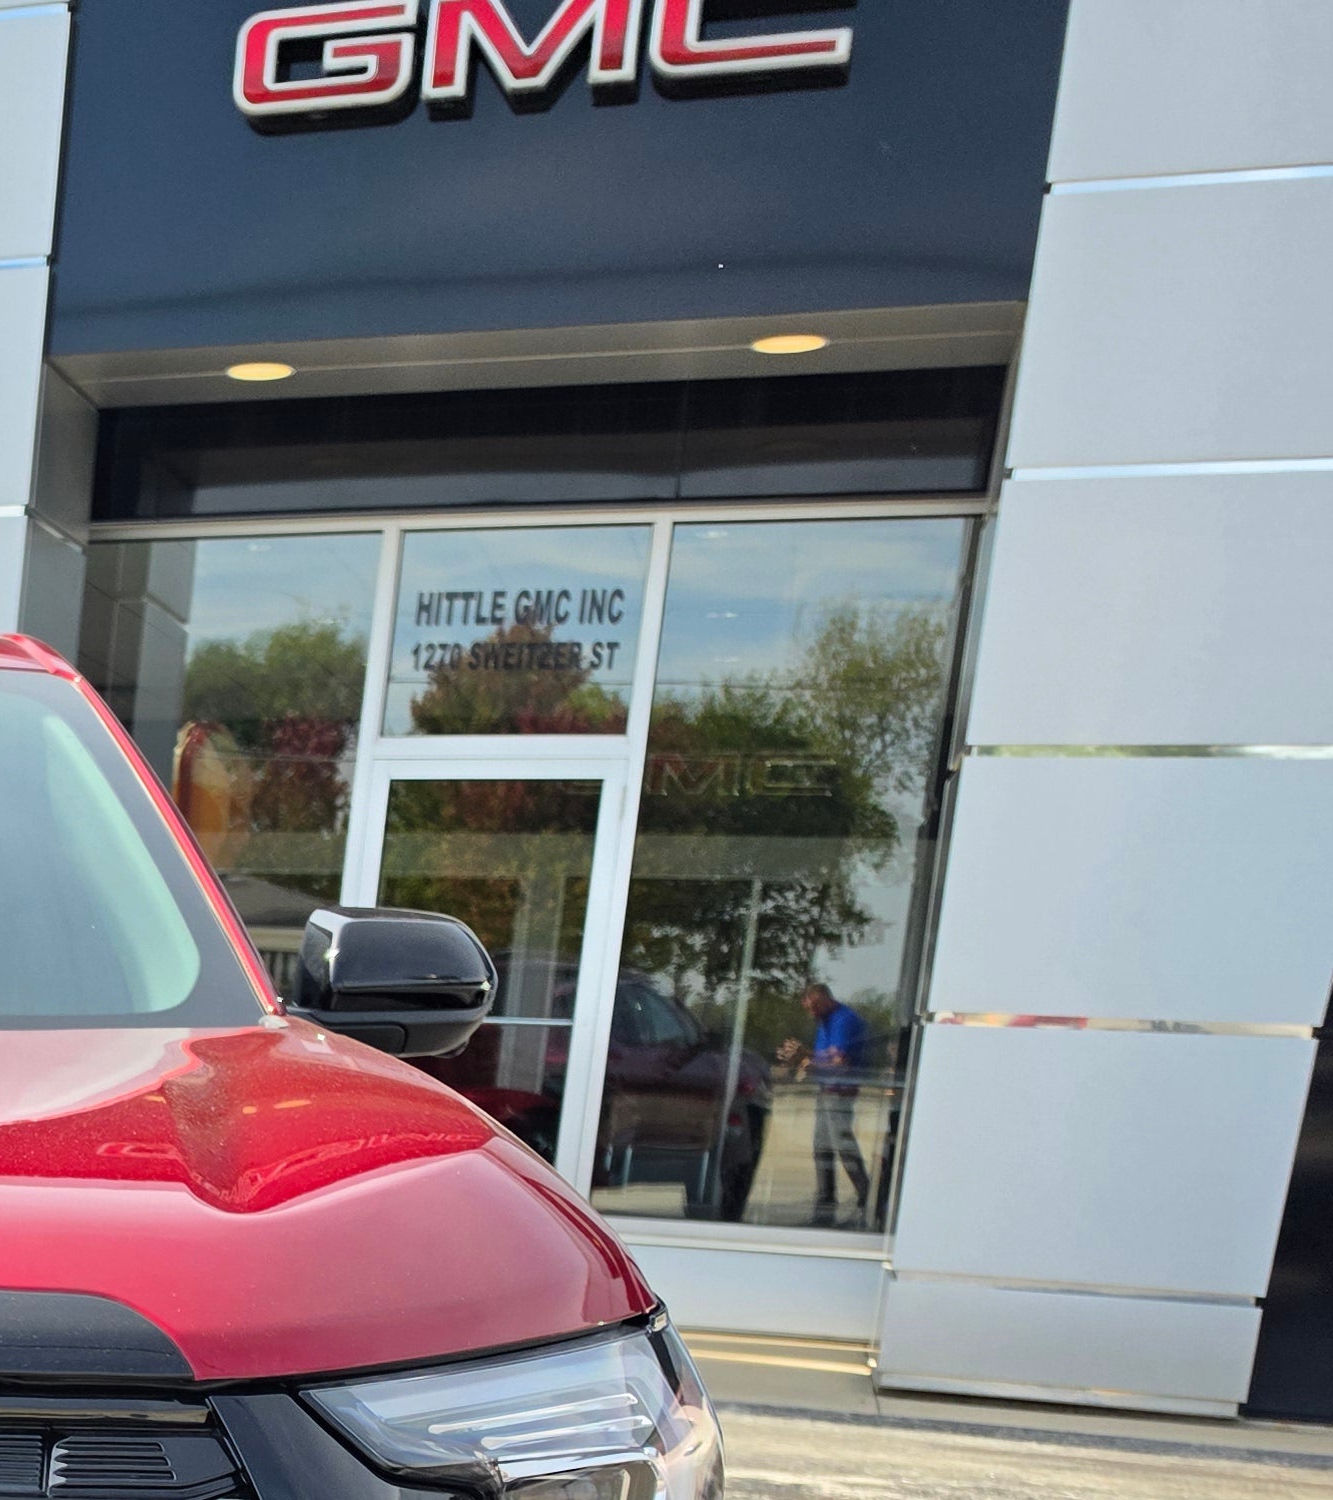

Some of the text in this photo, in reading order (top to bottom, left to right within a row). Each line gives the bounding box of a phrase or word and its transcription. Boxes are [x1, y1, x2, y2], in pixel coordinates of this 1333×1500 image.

[232, 0, 852, 115] GMC
[415, 588, 624, 626] HITTLE GMC INC
[412, 641, 620, 671] 1270 SWEITZER ST
